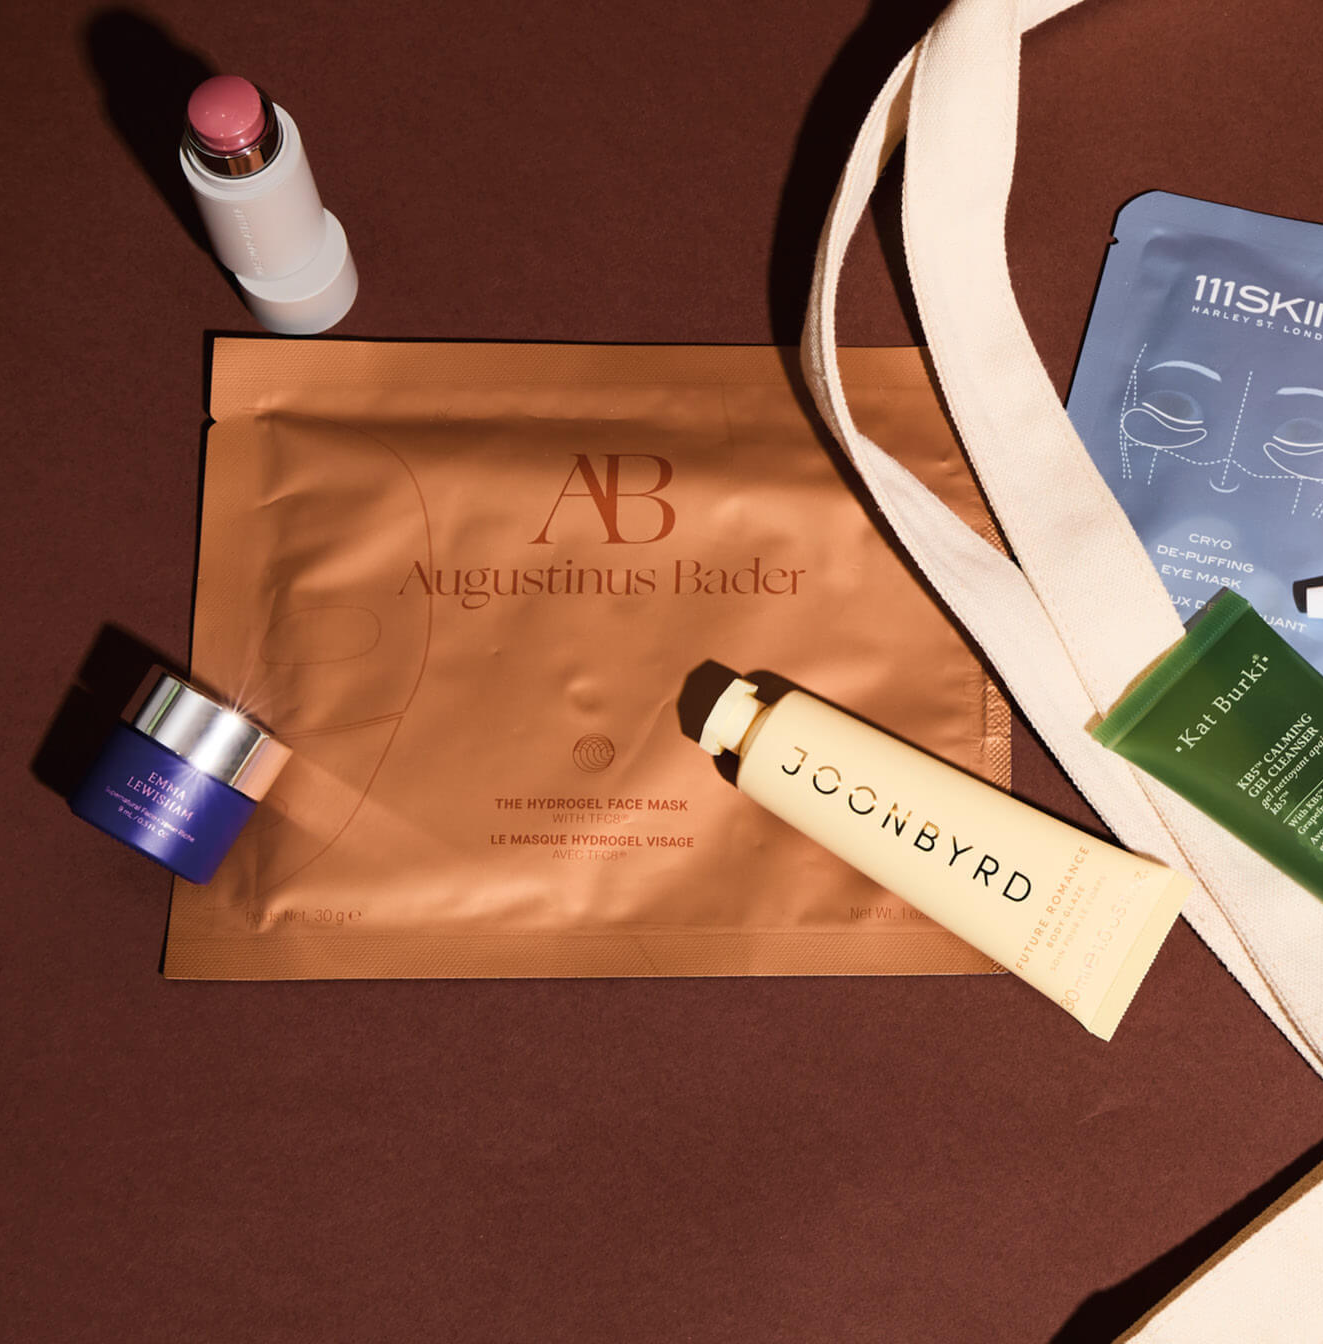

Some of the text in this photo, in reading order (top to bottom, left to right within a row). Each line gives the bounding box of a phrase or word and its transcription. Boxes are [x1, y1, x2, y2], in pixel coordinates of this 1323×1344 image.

[1191, 305, 1251, 324] HARLEY
[1255, 319, 1275, 330] ST.
[527, 453, 677, 545] AB
[1188, 533, 1232, 550] CRYO
[1156, 544, 1254, 573] DE-PUFFING
[397, 557, 807, 610] Augustinus Bader
[1161, 564, 1242, 590] EYE MASK
[1177, 713, 1217, 750] Kat
[1263, 712, 1313, 764] CALMING
[1247, 725, 1319, 798] GEL CLEANSER
[147, 771, 187, 801] EMMA
[1261, 791, 1275, 810] gel
[1273, 756, 1310, 793] nettoyant
[126, 775, 194, 822] LEWISHAM
[495, 798, 689, 812] THE HYDROGEL FACE MASK
[552, 813, 586, 824] WITH
[780, 745, 1033, 903] JOONBYRD
[1288, 808, 1309, 829] With
[490, 834, 695, 848] LE MASQUE HYDROGEL VISAGE
[850, 906, 872, 920] Net
[1015, 918, 1049, 970] FUTURE
[1045, 845, 1090, 915] ROMANCE
